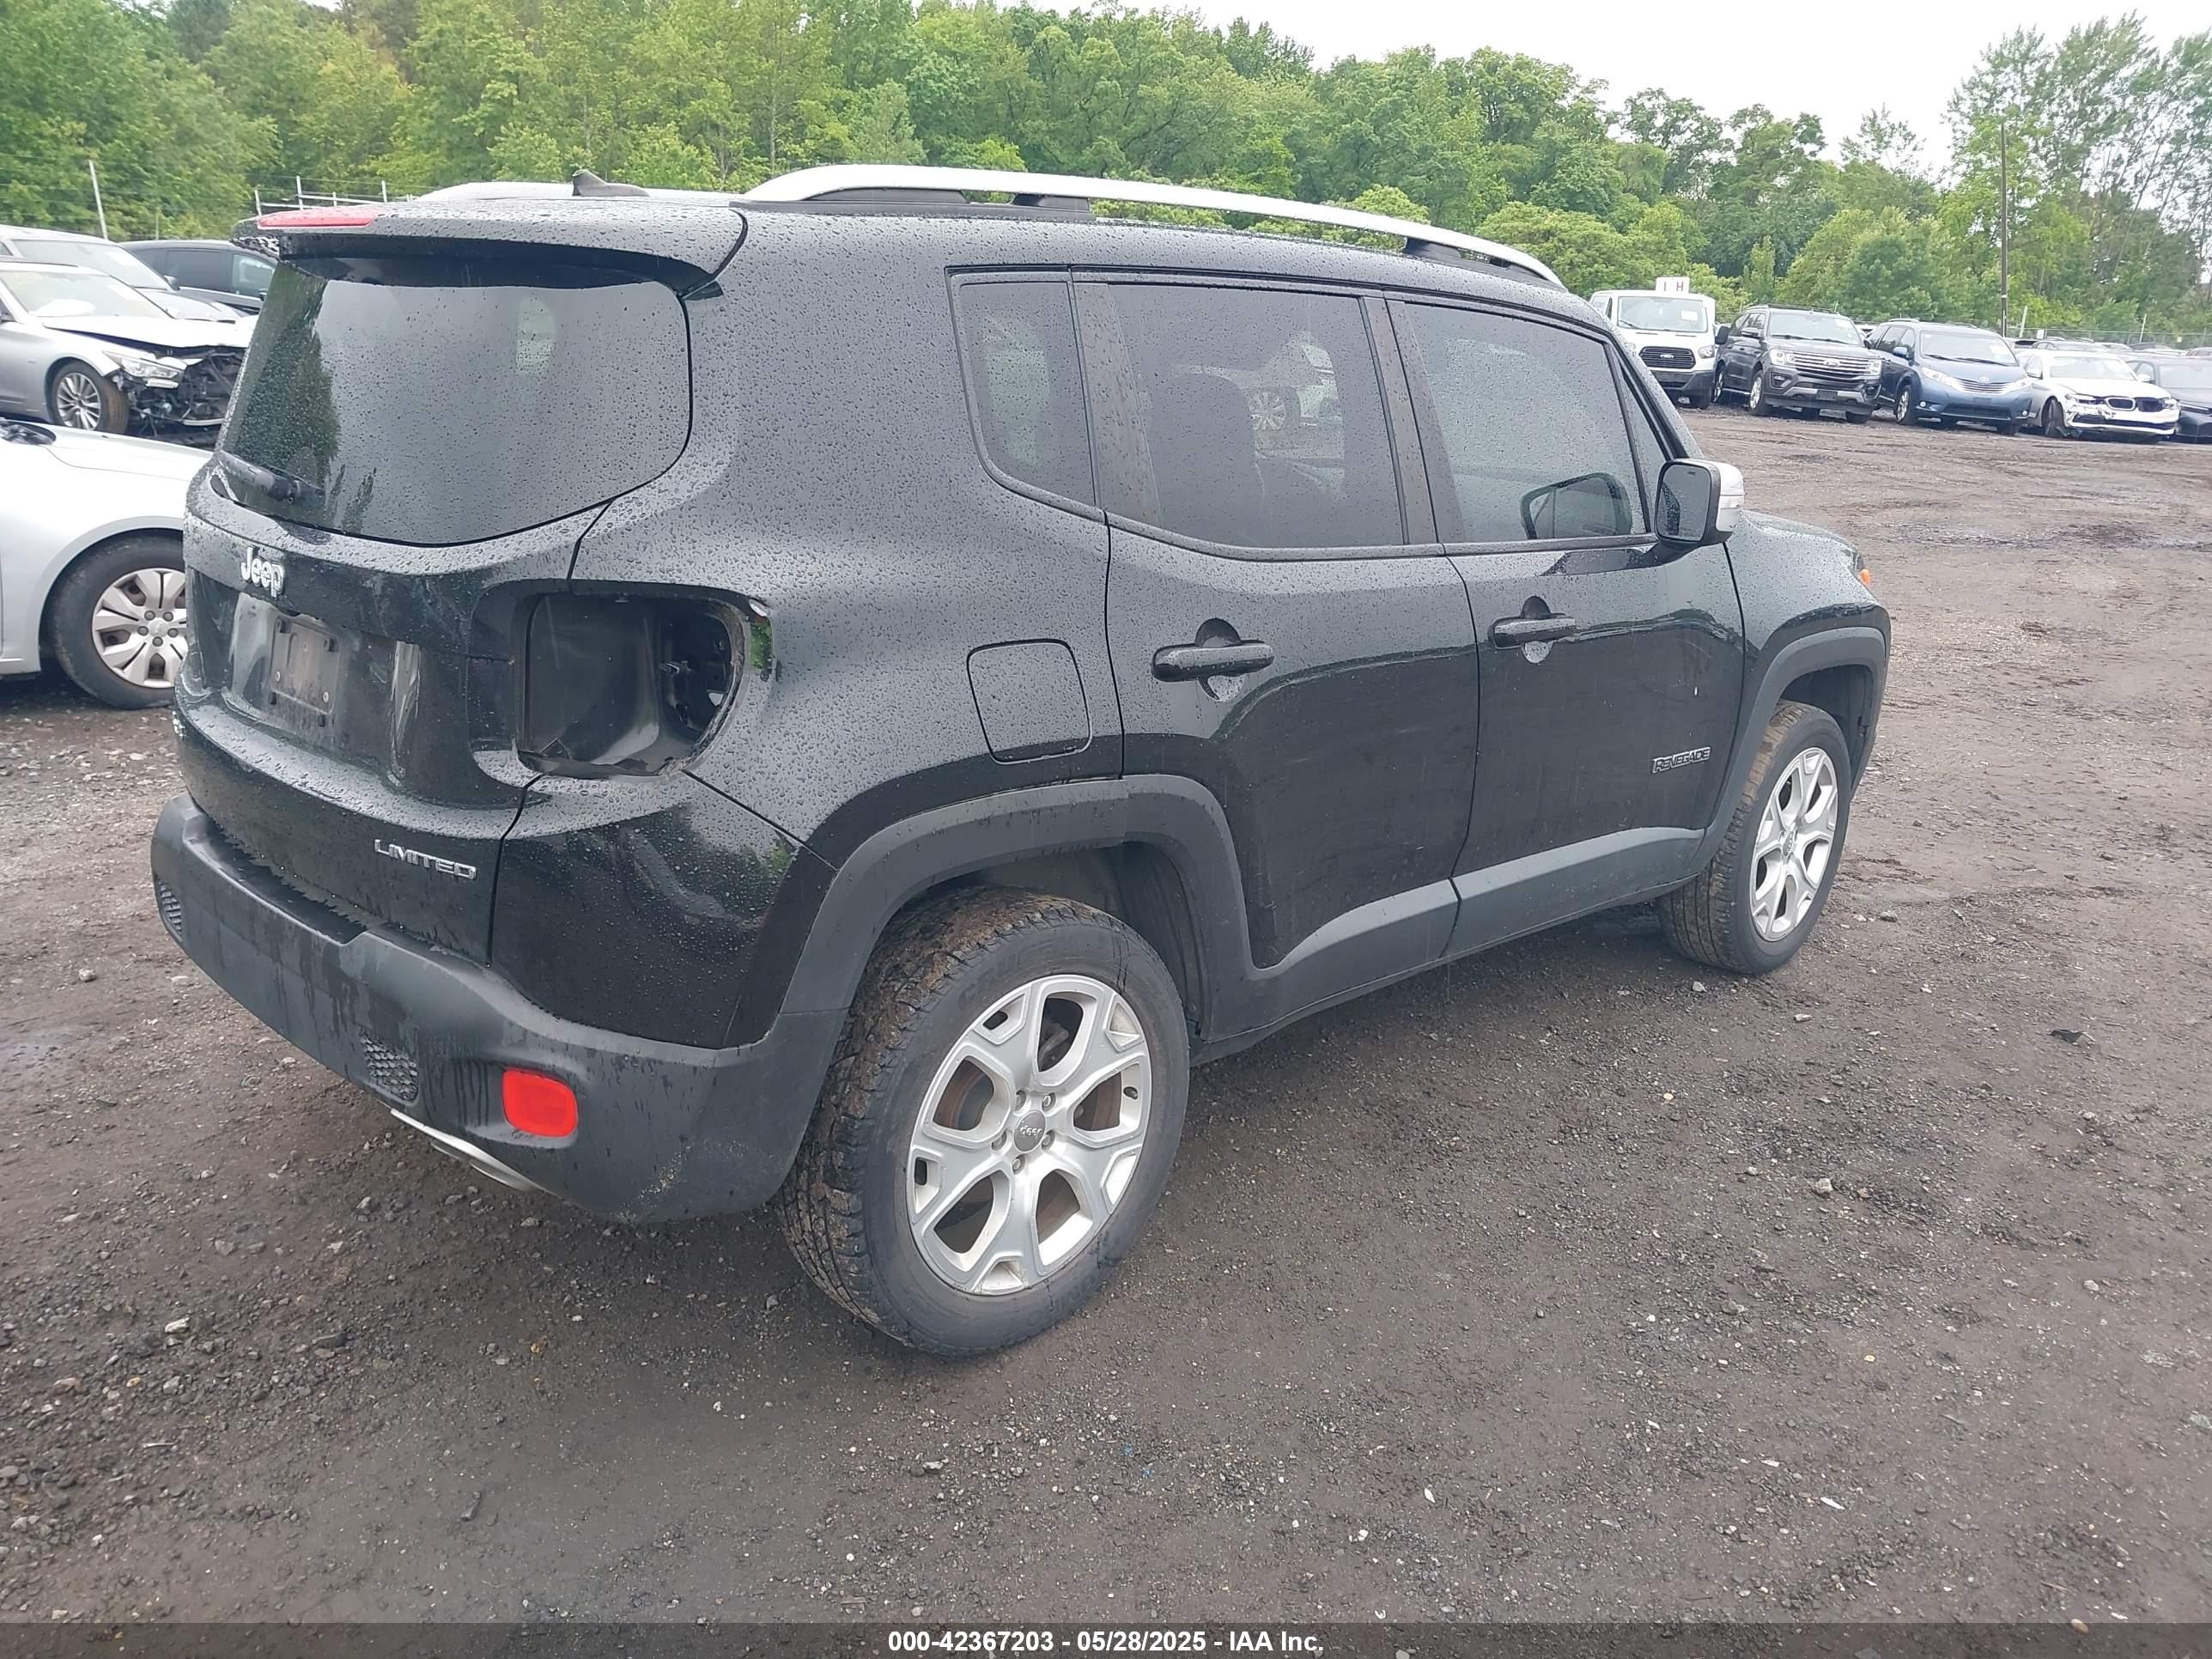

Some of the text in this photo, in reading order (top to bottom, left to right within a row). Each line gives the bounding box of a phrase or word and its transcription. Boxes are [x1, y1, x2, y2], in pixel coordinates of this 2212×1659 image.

[240, 546, 285, 599] Jeep
[1651, 746, 1711, 774] RENEGADE
[374, 839, 477, 880] LIMITED
